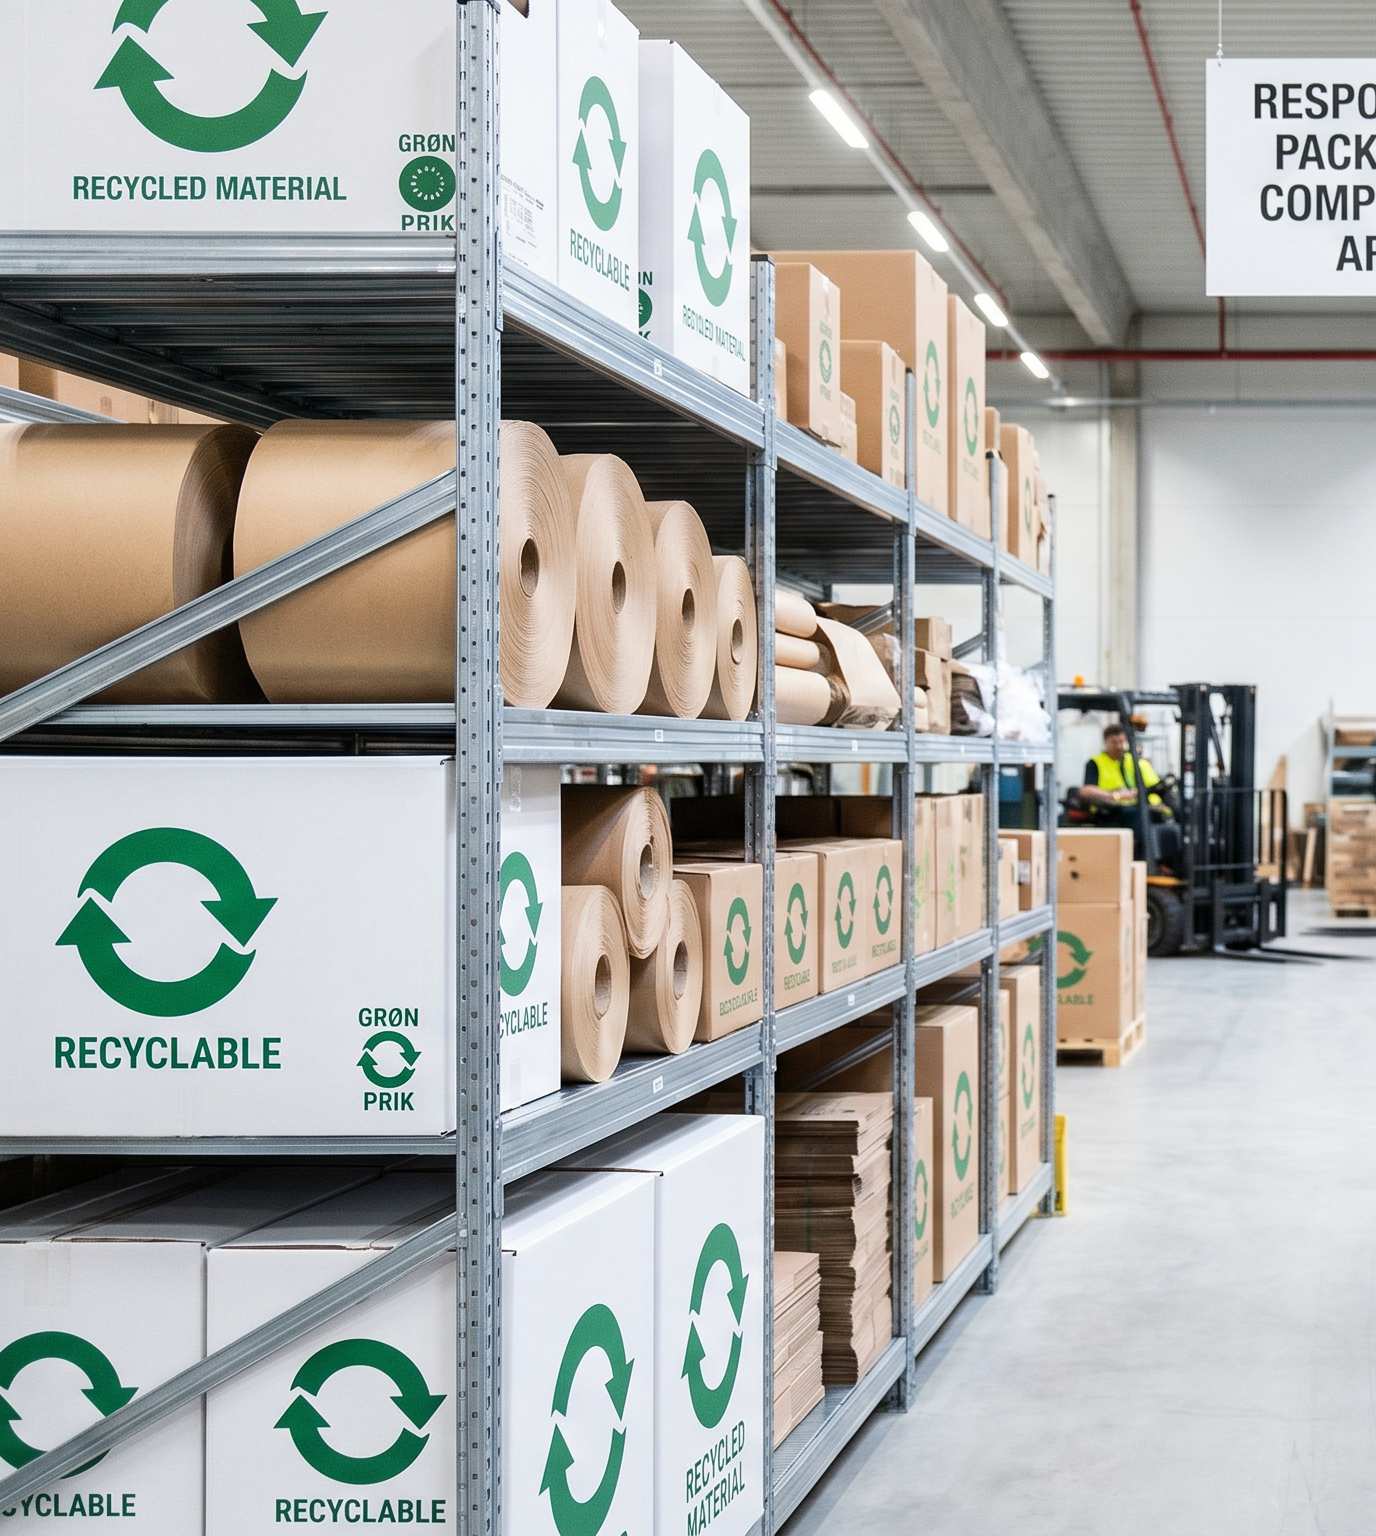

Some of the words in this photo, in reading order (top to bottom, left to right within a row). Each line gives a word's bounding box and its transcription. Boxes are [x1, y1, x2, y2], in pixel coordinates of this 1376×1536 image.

[398, 133, 456, 152] GRØN
[73, 176, 206, 201] RECYCLED
[216, 176, 347, 201] MATERIAL
[401, 214, 454, 231] PRIK
[570, 228, 630, 292] RECYCLABLE
[358, 1008, 419, 1027] GRØN
[499, 1001, 549, 1039] CYCLABLE
[55, 1036, 282, 1070] RECYCLABLE
[363, 1091, 415, 1111] PRIK
[686, 1419, 745, 1503] RECYCLED
[687, 1461, 746, 1536] MATERIAL
[276, 1499, 447, 1524] RECYCLABLE
